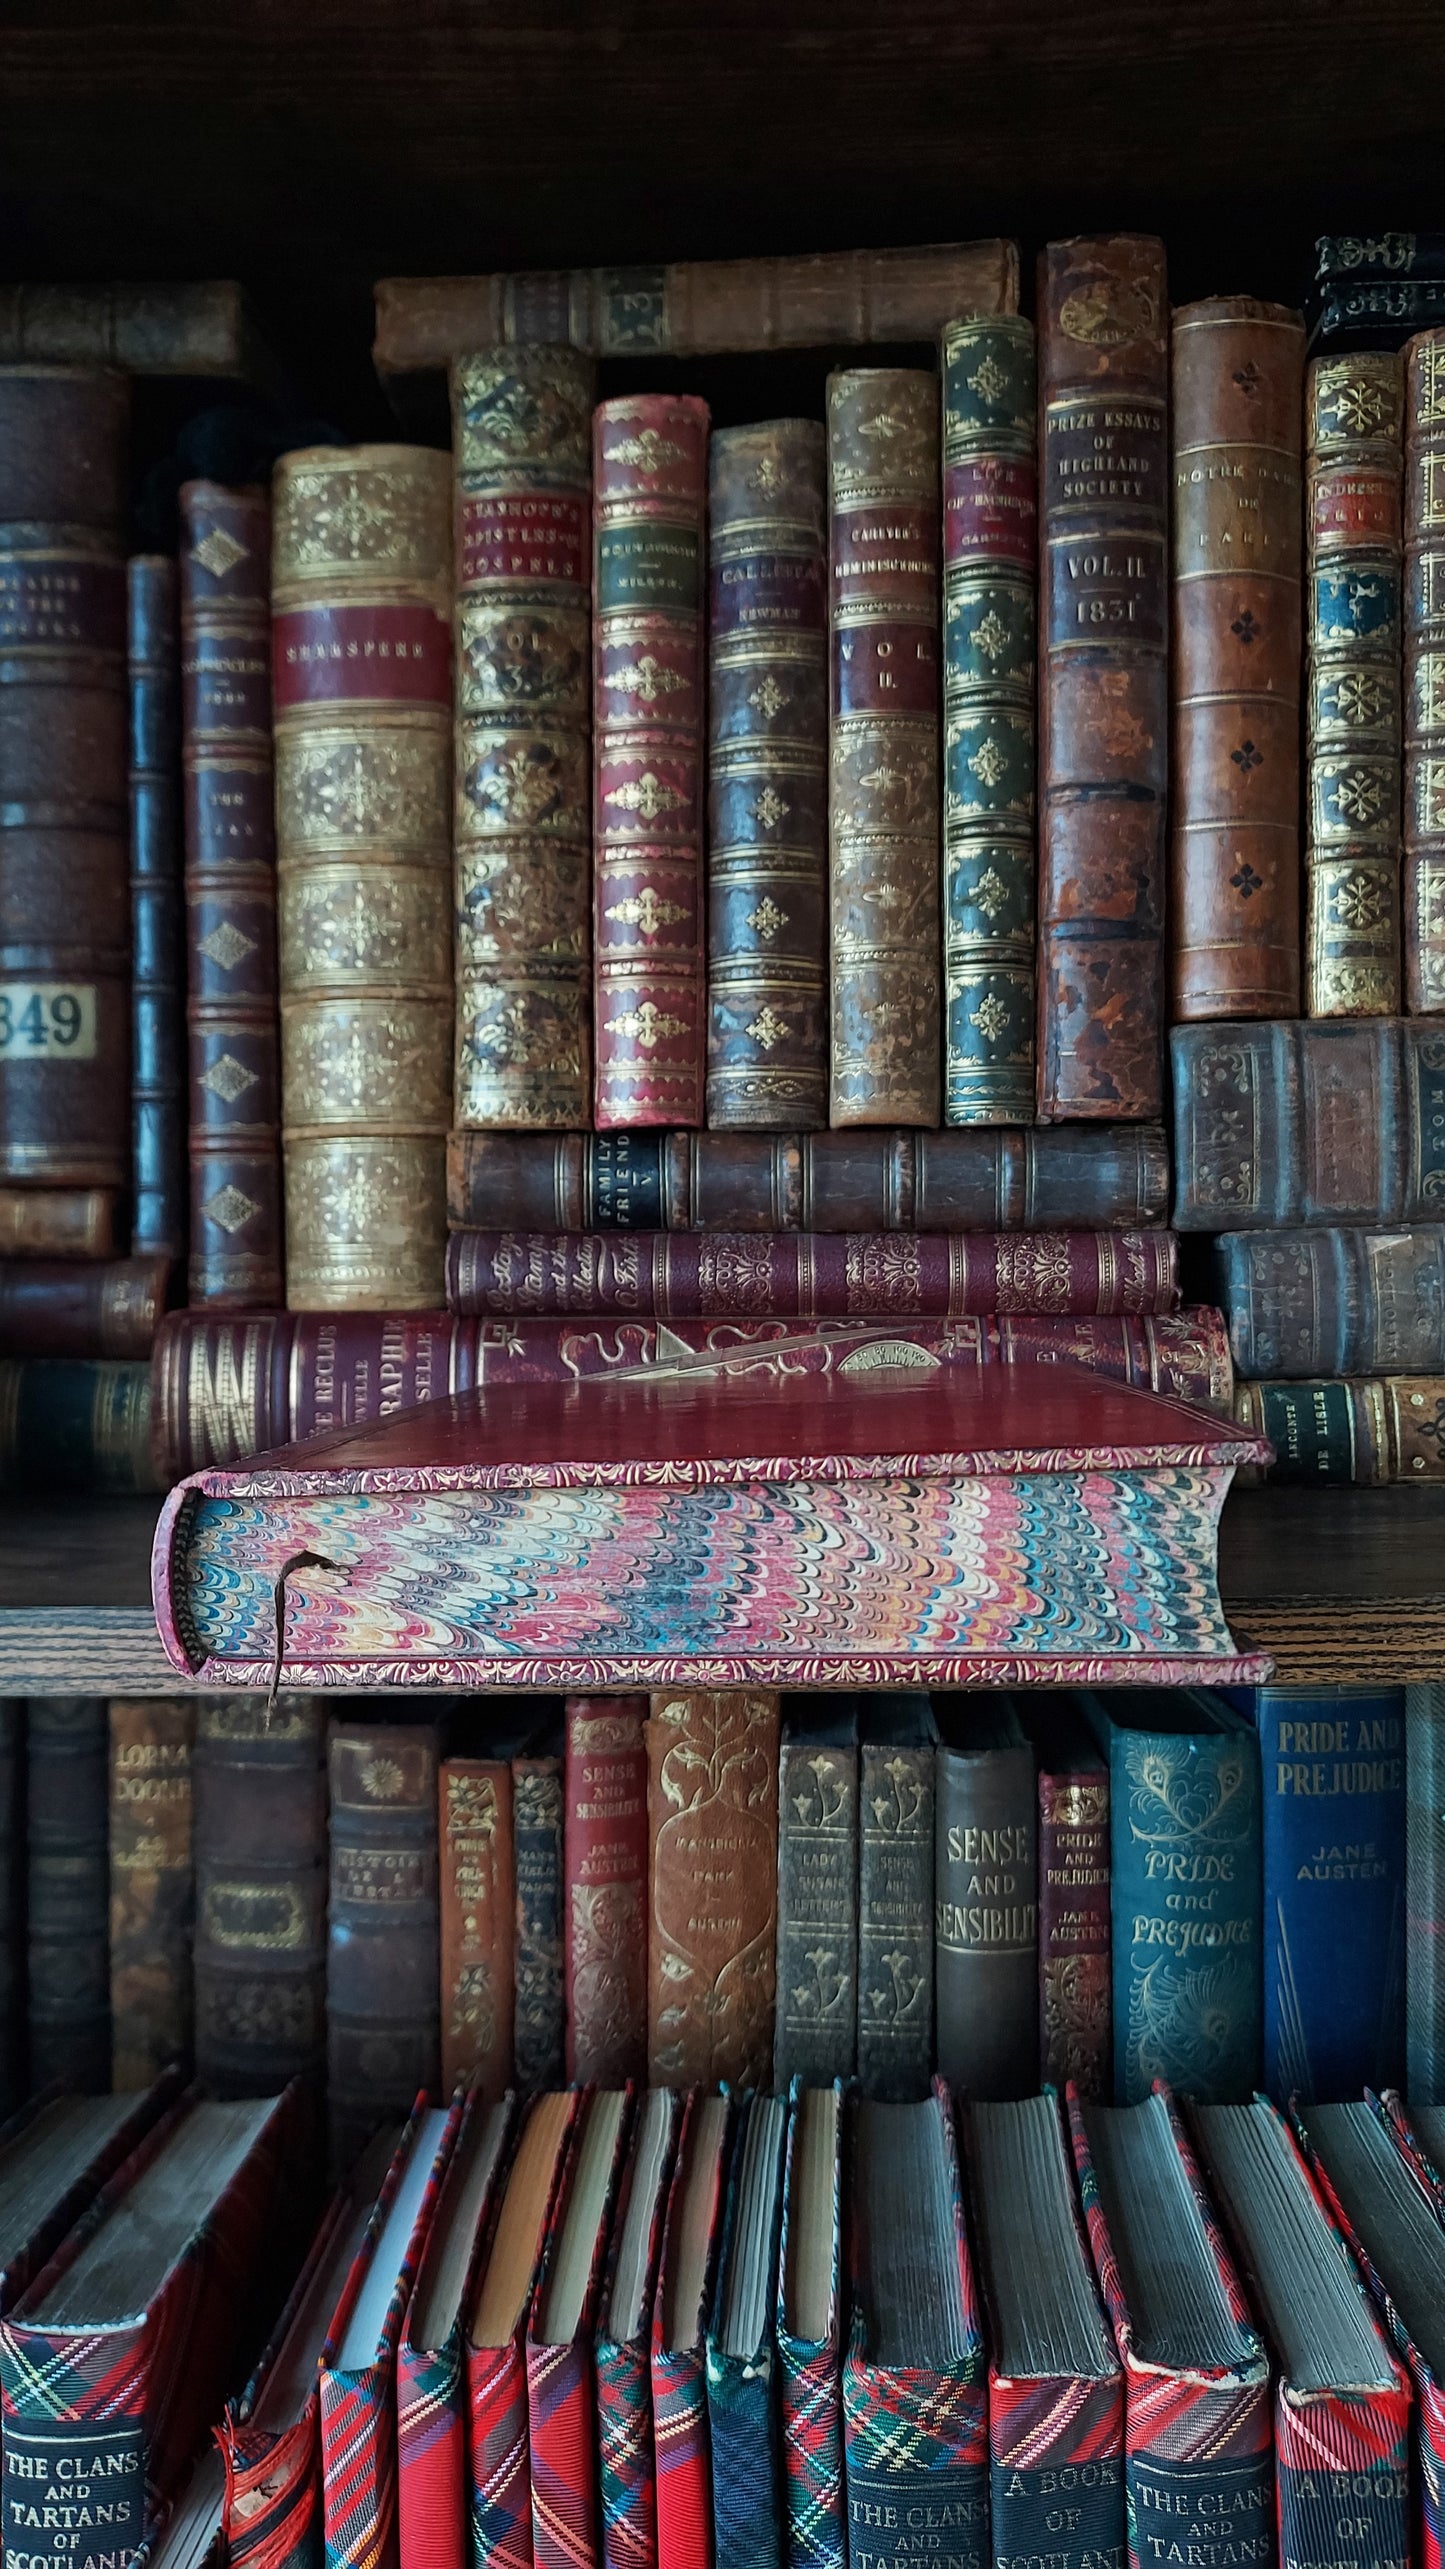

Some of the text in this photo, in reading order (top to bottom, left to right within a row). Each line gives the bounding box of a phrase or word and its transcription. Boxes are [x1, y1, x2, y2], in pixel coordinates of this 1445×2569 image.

[1048, 411, 1161, 435] PRIZE ESSAYS
[1093, 434, 1115, 451] OF
[1059, 454, 1150, 476] HIGHLAND
[1178, 464, 1246, 487] NOTRE
[1062, 479, 1144, 498] SOCIETY
[1199, 531, 1287, 547] PARI
[1077, 599, 1136, 624] 1831
[599, 1138, 611, 1216] FAMILY
[616, 1135, 630, 1223] FRIEND
[487, 1233, 523, 1312] Postage
[611, 1236, 639, 1290] Firth
[893, 1346, 909, 1355] 100
[912, 1351, 926, 1362] 120
[313, 1324, 337, 1403] RECLUS
[1285, 1404, 1298, 1459] LECONTE
[1312, 1391, 1330, 1471] DE LISLE
[1277, 1718, 1402, 1754] PRIDE AND
[114, 1743, 191, 1767] LORNA
[581, 1763, 637, 1783] SENSE
[1276, 1758, 1402, 1796] PREJUDICE
[592, 1784, 626, 1799] AND
[575, 1798, 640, 1820] SENSIBILITY
[587, 1842, 630, 1858] JANE
[947, 1824, 1028, 1866] SENSE
[1056, 1832, 1103, 1849] PRIDE
[802, 1853, 839, 1867] LADY
[879, 1855, 914, 1870] SENSE
[1064, 1852, 1096, 1867] AND
[1311, 1843, 1377, 1861] JANE
[579, 1854, 639, 1875] AUSTEN
[1144, 1849, 1236, 1882] PRIDE
[1296, 1861, 1389, 1881] AUSTEN
[692, 1869, 735, 1883] PARK
[966, 1874, 1016, 1896] AND
[1046, 1867, 1110, 1887] PREJUDICE
[1165, 1888, 1220, 1911] and
[1058, 1911, 1101, 1925] JANE
[1049, 1924, 1109, 1942] AUSTEN
[1131, 1914, 1253, 1958] PREJUDICE
[5, 2450, 139, 2480] THE CLANS
[1003, 2462, 1120, 2497] A BOOK
[1295, 2473, 1410, 2499] A BOOK
[44, 2484, 91, 2500] AND
[1136, 2481, 1190, 2516] THE
[10, 2499, 131, 2528] TARTANS
[850, 2500, 899, 2528] THE
[1045, 2508, 1082, 2532] OF
[1186, 2520, 1234, 2537] AND
[1336, 2516, 1373, 2540] OF
[53, 2532, 81, 2549] OF
[894, 2534, 941, 2550] AND
[1146, 2533, 1271, 2567] TARTANS
